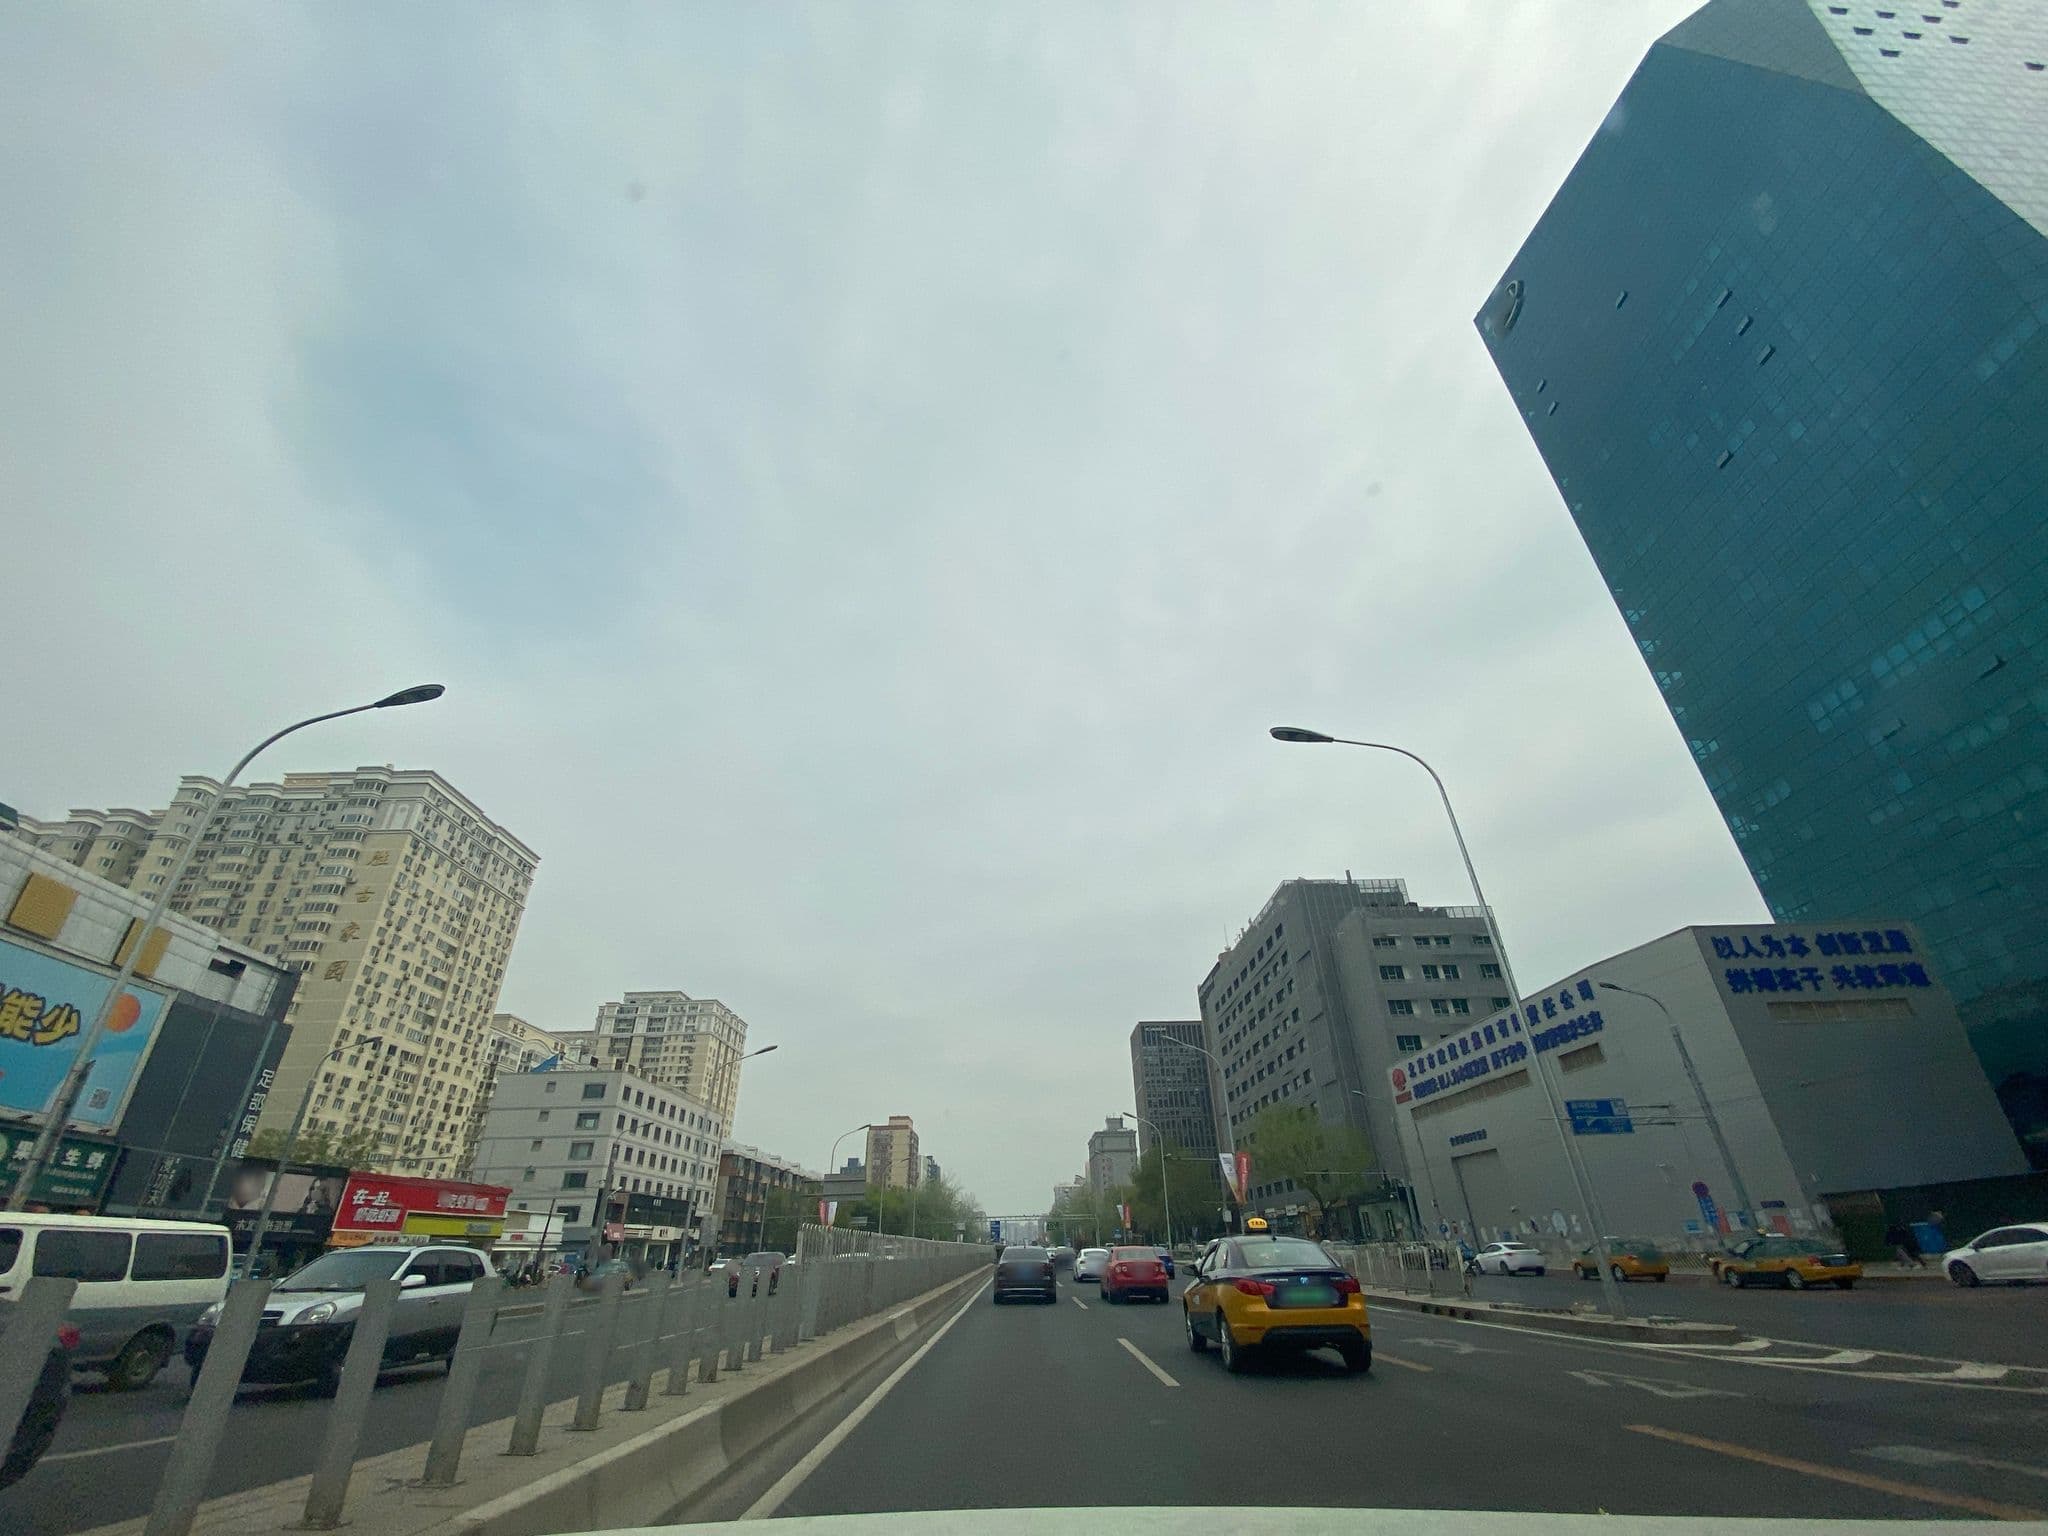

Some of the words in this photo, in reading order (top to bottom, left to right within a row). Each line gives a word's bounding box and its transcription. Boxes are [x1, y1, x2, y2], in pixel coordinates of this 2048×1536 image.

[1711, 935, 1810, 959] 以人为本
[12, 1140, 107, 1170] 果生鲜
